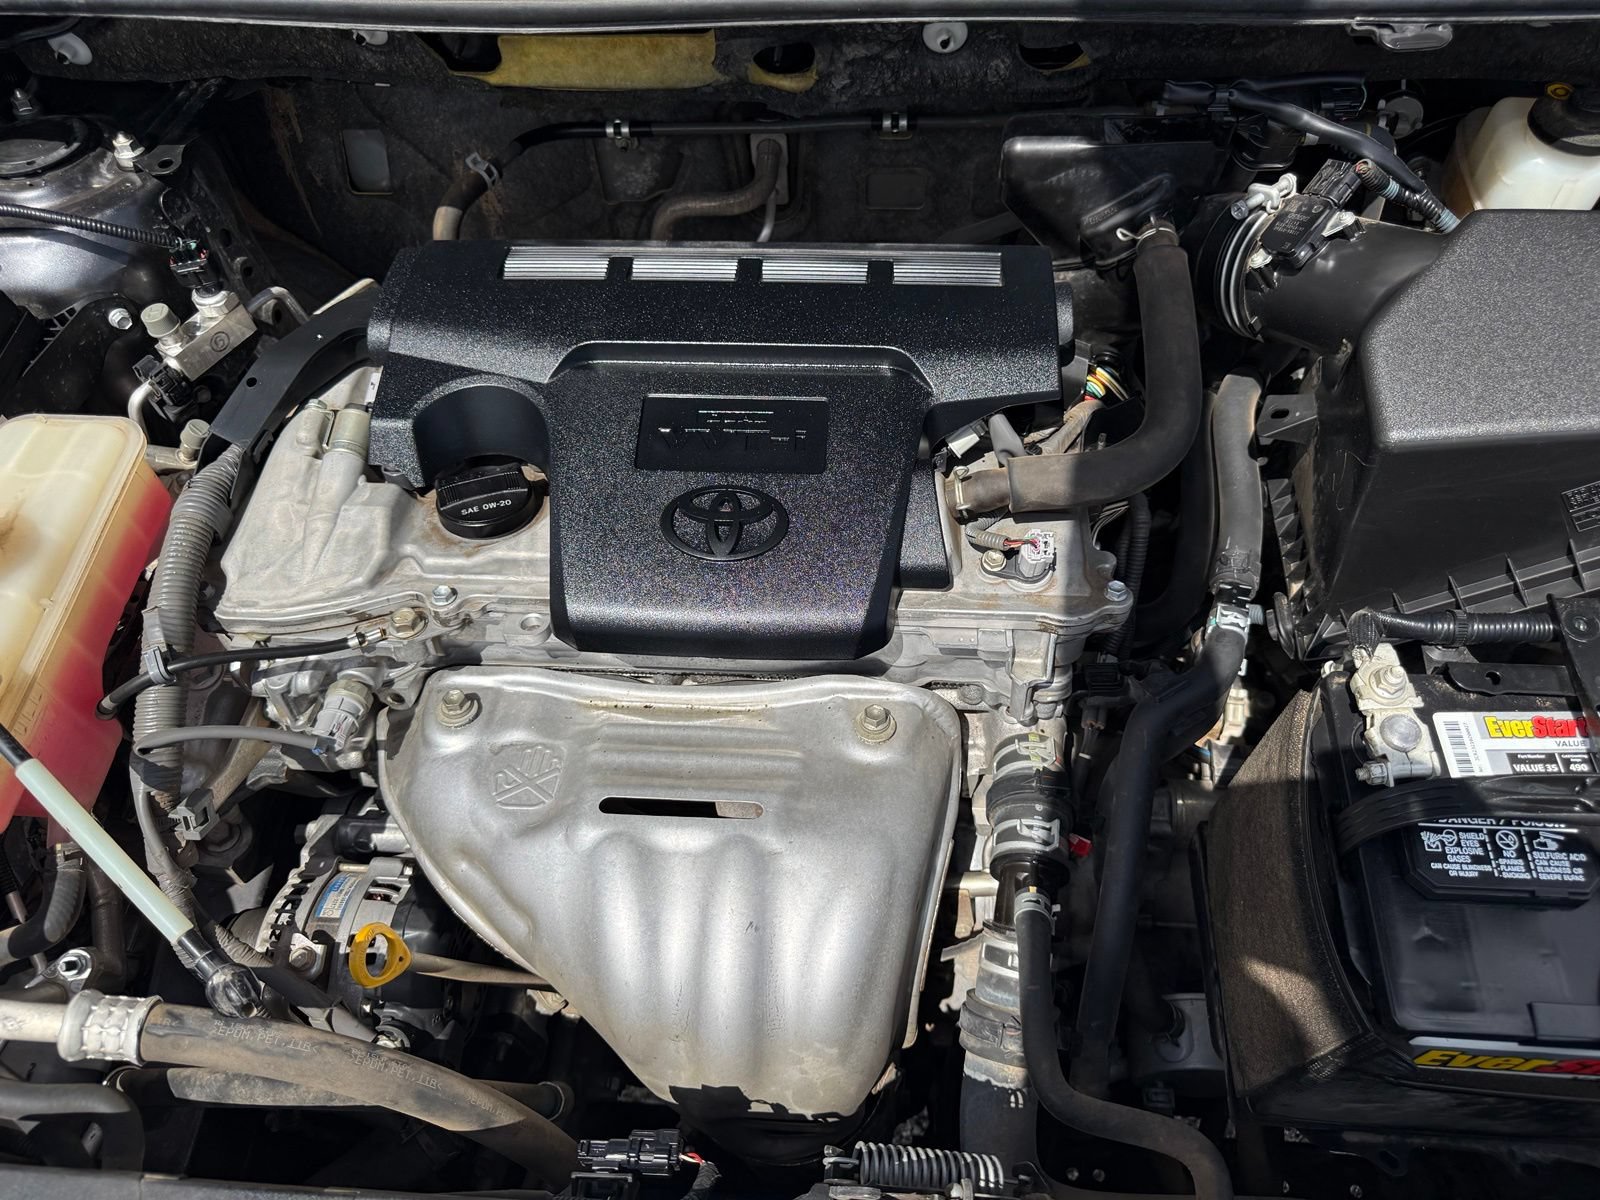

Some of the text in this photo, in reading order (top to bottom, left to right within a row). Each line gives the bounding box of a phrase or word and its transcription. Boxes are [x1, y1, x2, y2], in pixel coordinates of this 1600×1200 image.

[461, 505, 480, 516] SAE
[1483, 715, 1589, 738] EverStart
[1554, 740, 1587, 748] VALUE
[1512, 763, 1559, 772] VALUE 35
[1569, 763, 1588, 772] 490
[1458, 832, 1485, 840] SHIELD
[1460, 840, 1480, 848] EYES
[1445, 847, 1485, 856] EXPLOSIVE
[1503, 850, 1516, 858] NO
[1533, 851, 1568, 861] SULFURIC
[1447, 855, 1471, 863] GASES
[1413, 1049, 1600, 1075] EverS
